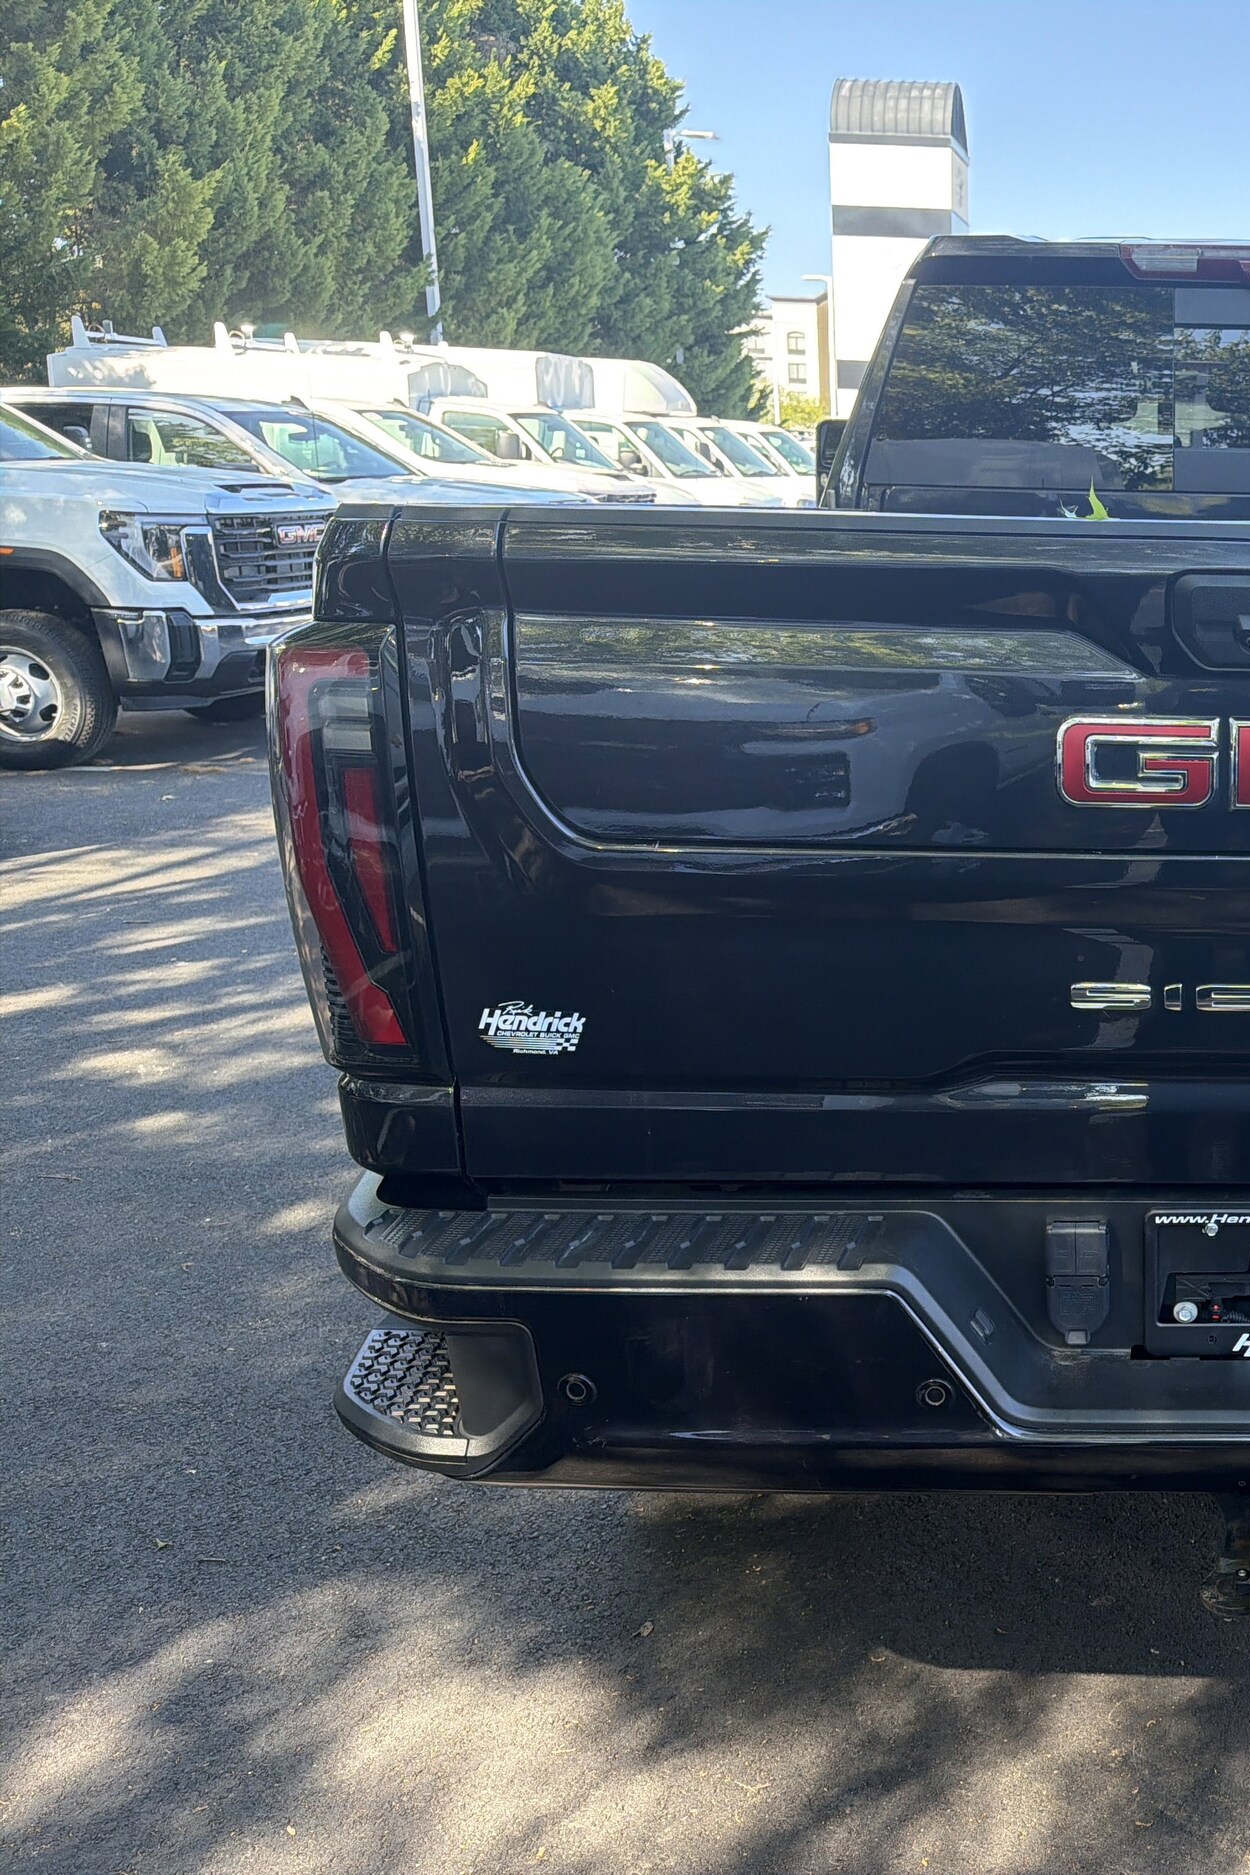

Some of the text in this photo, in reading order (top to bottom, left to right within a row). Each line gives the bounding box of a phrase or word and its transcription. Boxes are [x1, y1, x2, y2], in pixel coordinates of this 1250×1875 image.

[277, 523, 325, 544] GMC
[478, 1008, 586, 1036] Hendrick
[496, 1030, 538, 1038] CHEVROLET
